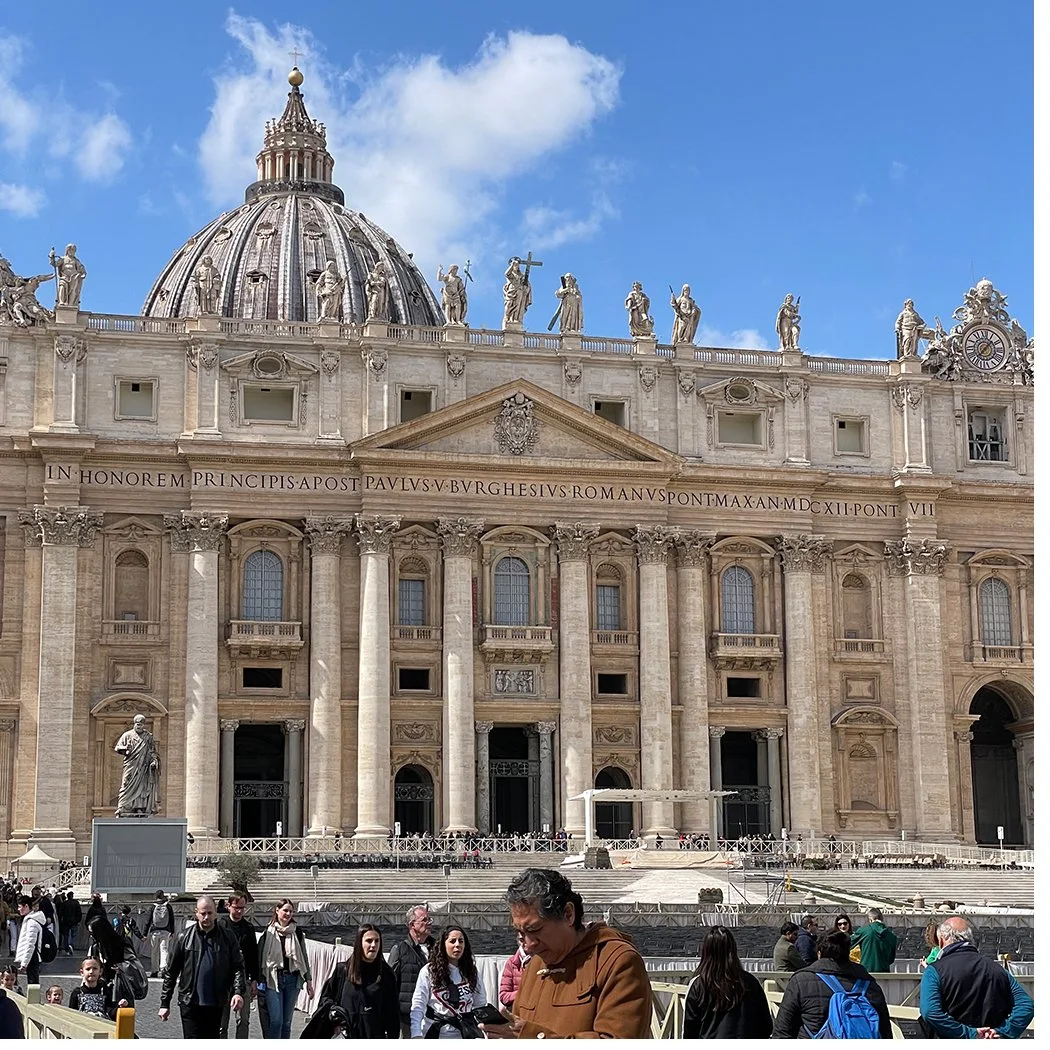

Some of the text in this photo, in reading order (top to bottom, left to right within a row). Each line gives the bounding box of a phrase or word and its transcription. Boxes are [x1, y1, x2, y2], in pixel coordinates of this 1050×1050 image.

[47, 465, 72, 480] IN
[80, 470, 185, 488] HONOREM
[193, 472, 295, 490] PRINCIPIS
[365, 475, 430, 492] PAVLVS
[450, 479, 567, 498] BVRGHESIVS
[572, 485, 666, 502] ROMANVS
[909, 502, 934, 516] VII
